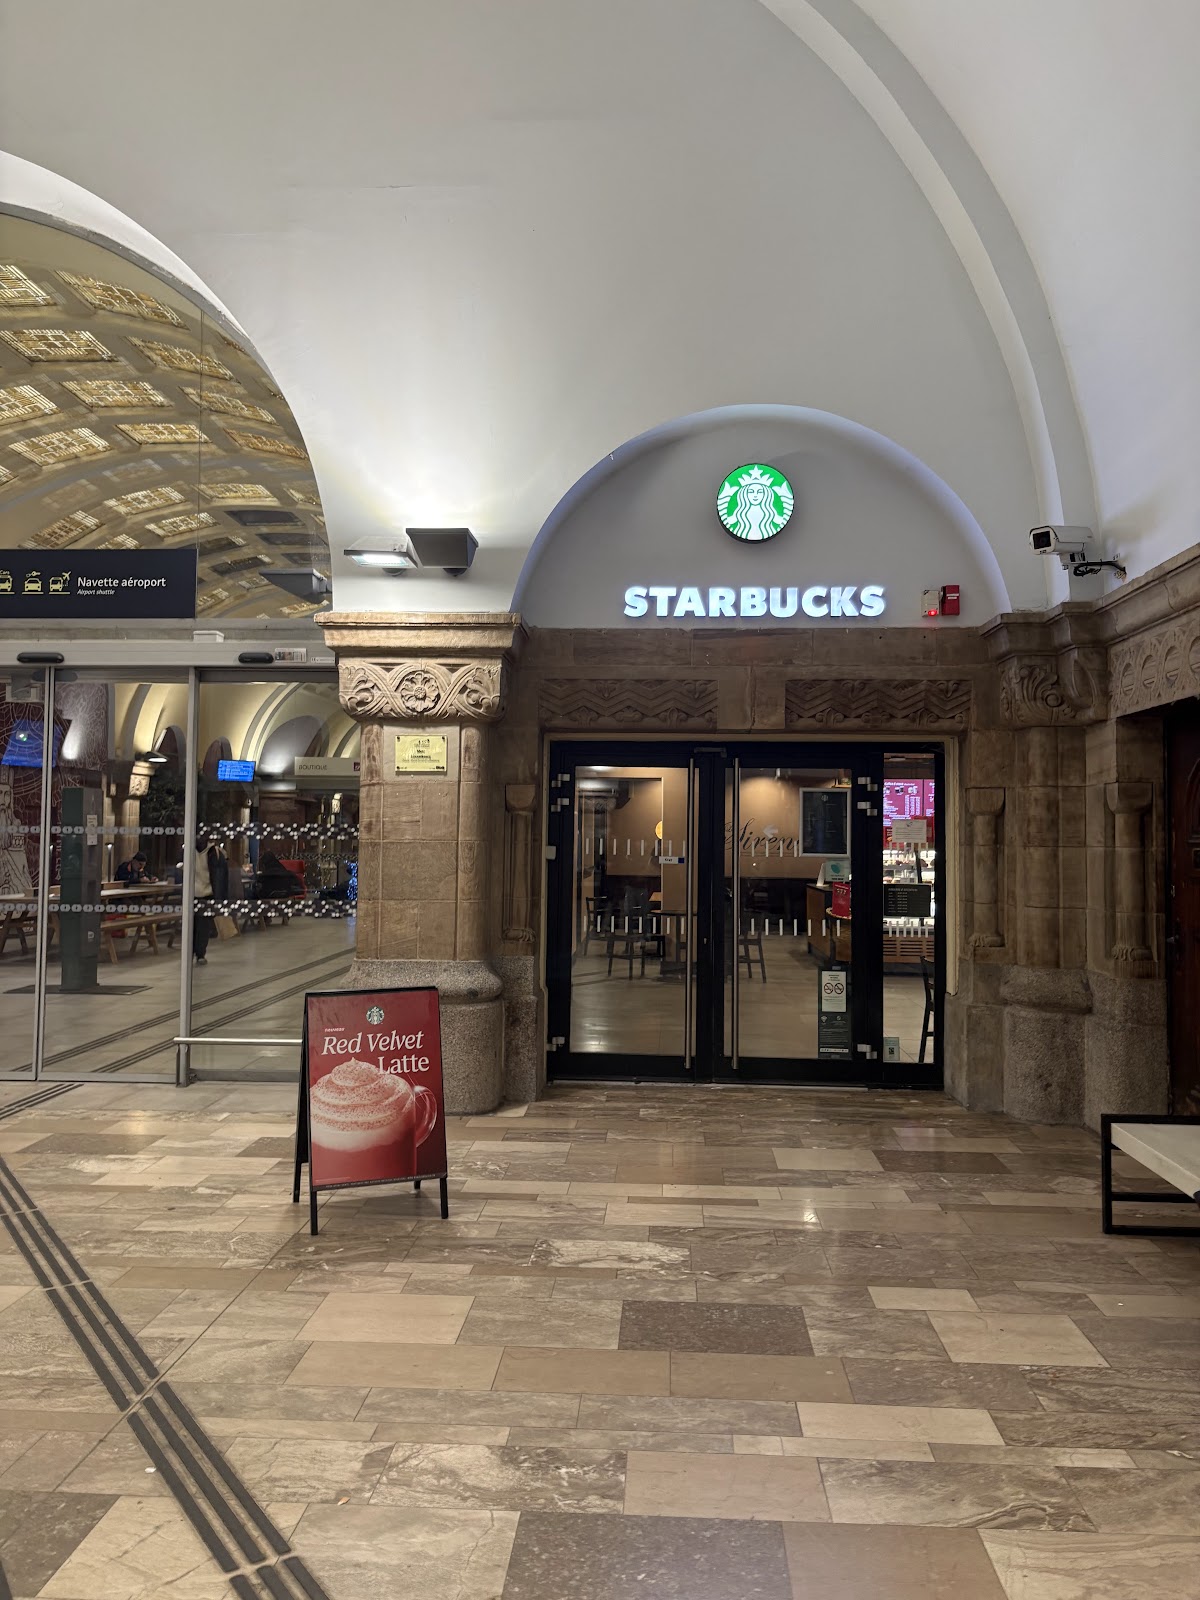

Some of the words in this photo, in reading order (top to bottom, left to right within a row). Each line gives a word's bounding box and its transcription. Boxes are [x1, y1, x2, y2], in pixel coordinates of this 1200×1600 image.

[77, 576, 119, 587] Navette
[121, 576, 167, 589] aéroport
[77, 588, 96, 596] Airport
[96, 588, 115, 596] shuttle
[623, 586, 886, 618] STARBUCKS
[321, 1032, 363, 1056] Red
[367, 1030, 424, 1052] Velvet
[377, 1054, 430, 1075] Latte
